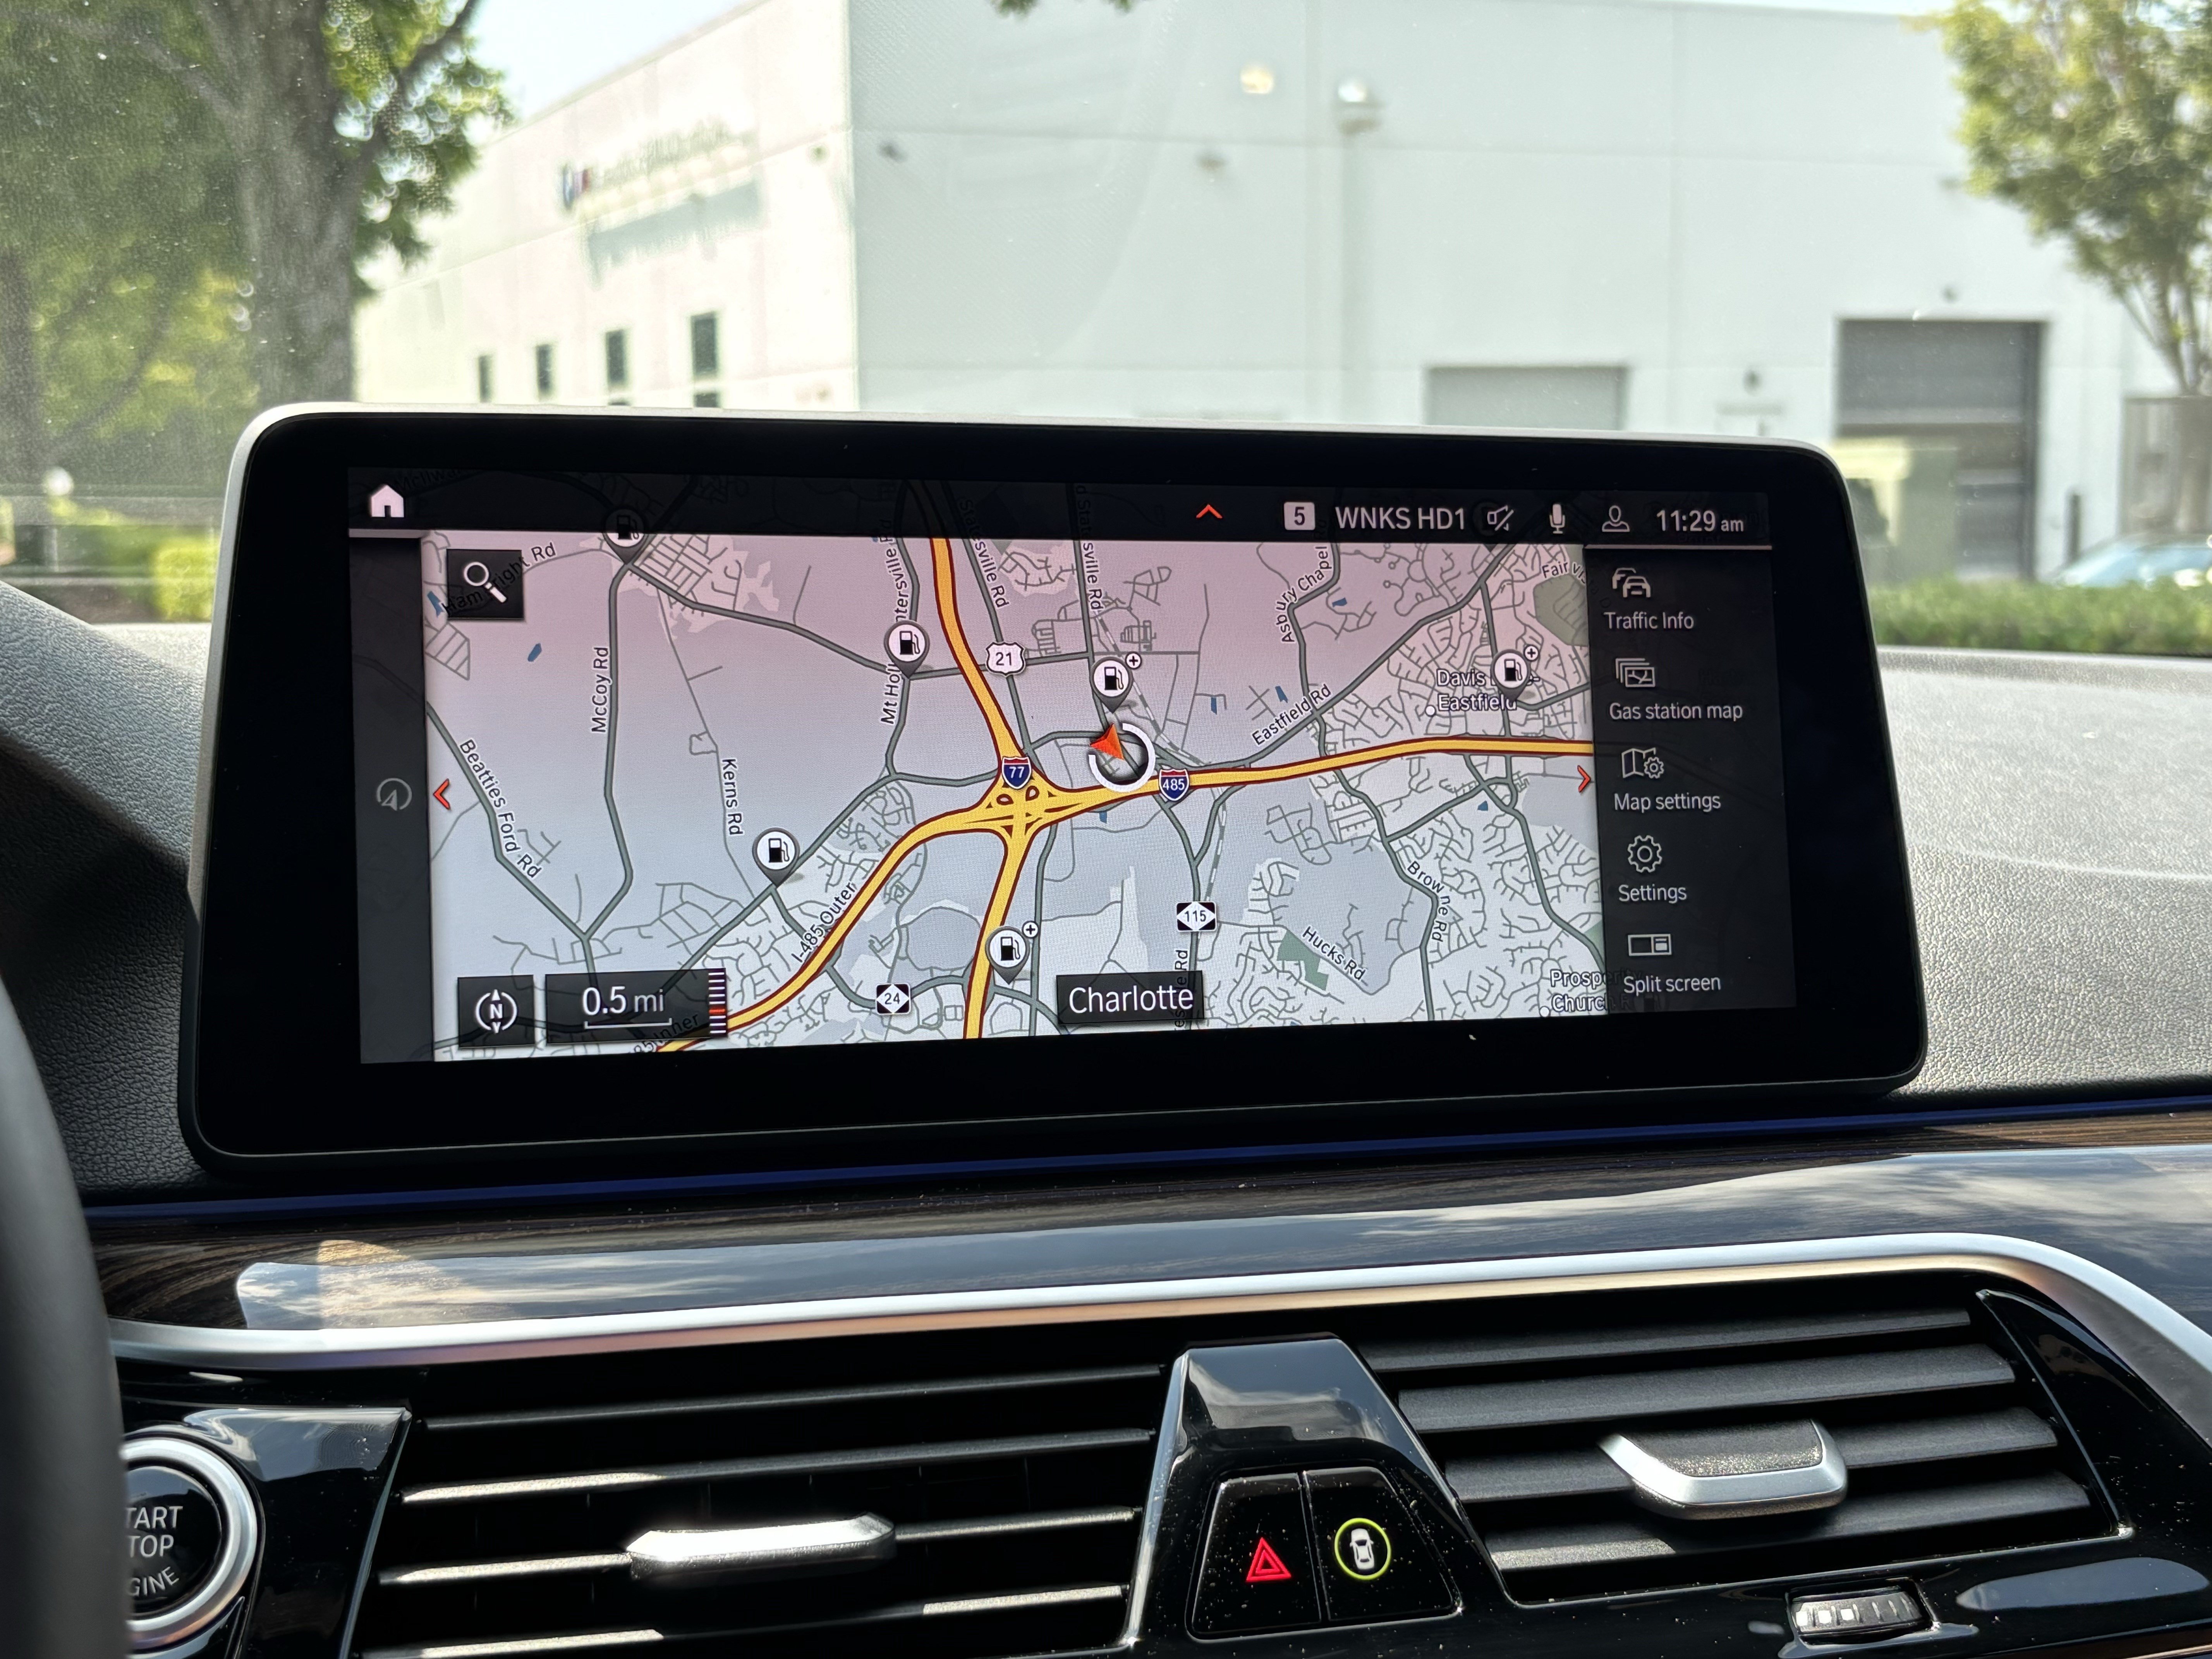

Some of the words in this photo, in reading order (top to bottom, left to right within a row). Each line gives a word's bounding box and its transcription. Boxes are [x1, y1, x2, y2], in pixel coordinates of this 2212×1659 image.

[1294, 506, 1305, 526] 5
[1336, 507, 1410, 529] WNKS
[1418, 508, 1465, 530] HD1
[1657, 510, 1716, 532] 11:29
[1721, 518, 1744, 532] am
[531, 542, 556, 561] Rd
[991, 585, 1009, 608] Rd
[1089, 588, 1103, 610] Rd
[1277, 587, 1297, 642] Asbury
[1297, 546, 1332, 592] Chapel
[1604, 612, 1657, 629] Traffic
[1663, 612, 1694, 629] Info
[593, 647, 608, 670] Rd
[995, 653, 1012, 666] 21
[1436, 669, 1486, 686] Davis
[592, 674, 612, 733] McCoy
[881, 700, 898, 725] Mt
[1252, 700, 1311, 745] Eastfield
[1310, 684, 1331, 704] Rd
[1609, 702, 1641, 720] Gas
[1645, 702, 1702, 720] station
[1707, 705, 1743, 722] map
[722, 759, 737, 808] Kerns
[1009, 766, 1025, 779] 77
[1163, 779, 1185, 791] 485
[459, 739, 506, 808] Beatties
[498, 812, 521, 853] Ford
[517, 854, 542, 878] Rd
[1614, 793, 1651, 812] Map
[1656, 793, 1721, 812] settings
[727, 813, 744, 835] Rd
[1407, 862, 1452, 916] Browne
[1431, 920, 1448, 943] Rd
[1619, 884, 1687, 903] Settings
[791, 925, 826, 963] I-485
[820, 881, 855, 924] Outer
[1184, 910, 1207, 922] 115
[1175, 950, 1188, 970] Rd
[1302, 926, 1345, 965] Hucks
[1344, 960, 1366, 981] Rd
[1623, 976, 1661, 995] Split
[1666, 976, 1721, 993] screen
[582, 986, 627, 1016] 0.5
[634, 989, 665, 1012] mi
[884, 992, 900, 1006] 24
[1069, 985, 1194, 1013] Charlotte
[489, 1003, 503, 1020] N
[125, 1505, 184, 1529] TART
[127, 1534, 175, 1558] TOP
[128, 1566, 180, 1597] GINE
